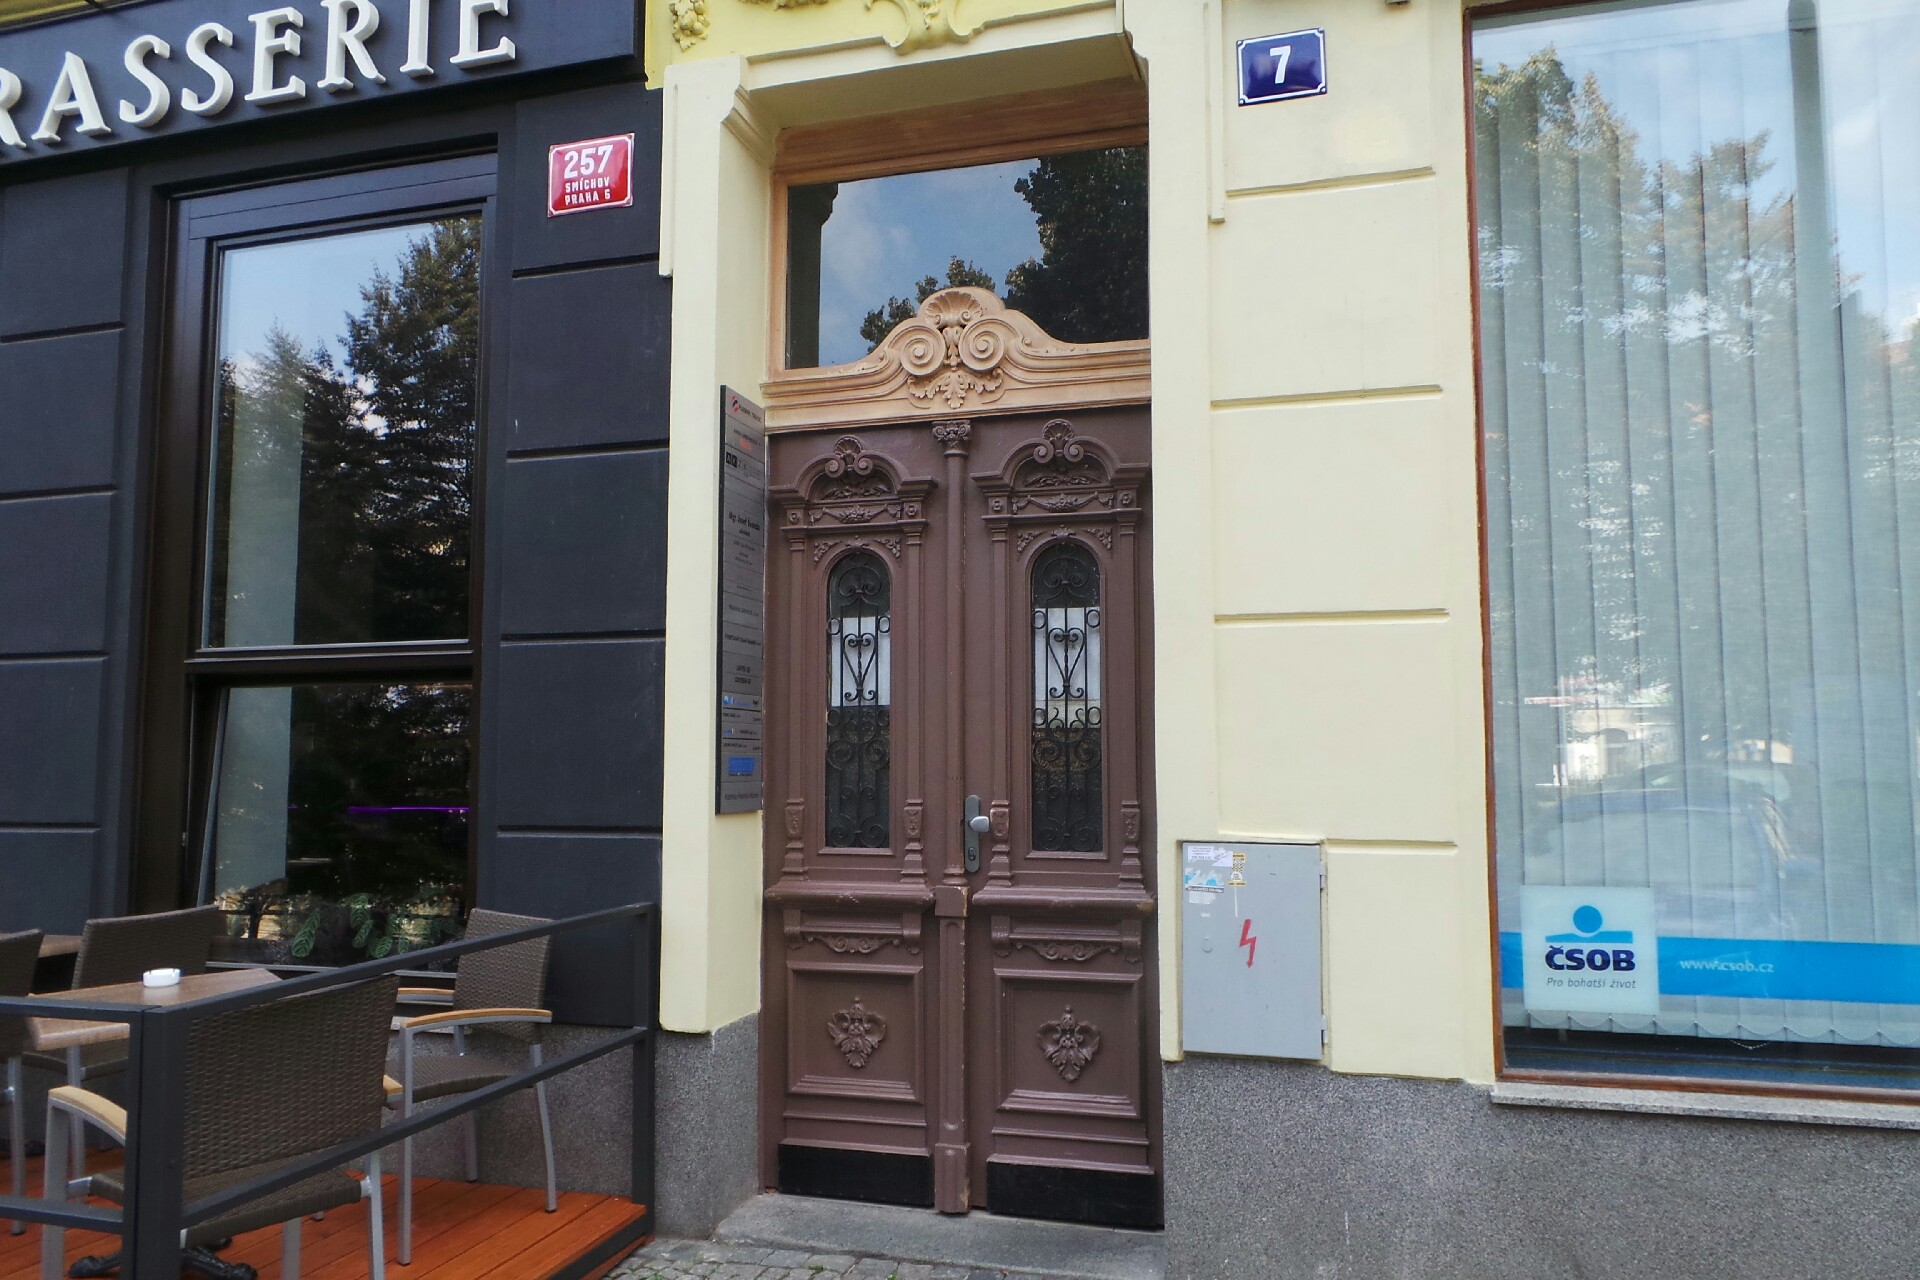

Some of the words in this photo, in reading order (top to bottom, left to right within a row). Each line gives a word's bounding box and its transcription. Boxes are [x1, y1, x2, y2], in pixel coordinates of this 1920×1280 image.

[1269, 44, 1291, 84] 7
[563, 144, 613, 179] 257
[565, 176, 610, 193] SMÍCHOV
[564, 190, 600, 206] PRAHA
[604, 188, 611, 200] 5
[1545, 945, 1636, 971] ČSOB
[1680, 959, 1775, 973] www.csob.cz
[1547, 977, 1563, 987] Pro
[1568, 978, 1606, 988] bohatší
[1610, 979, 1636, 989] život
